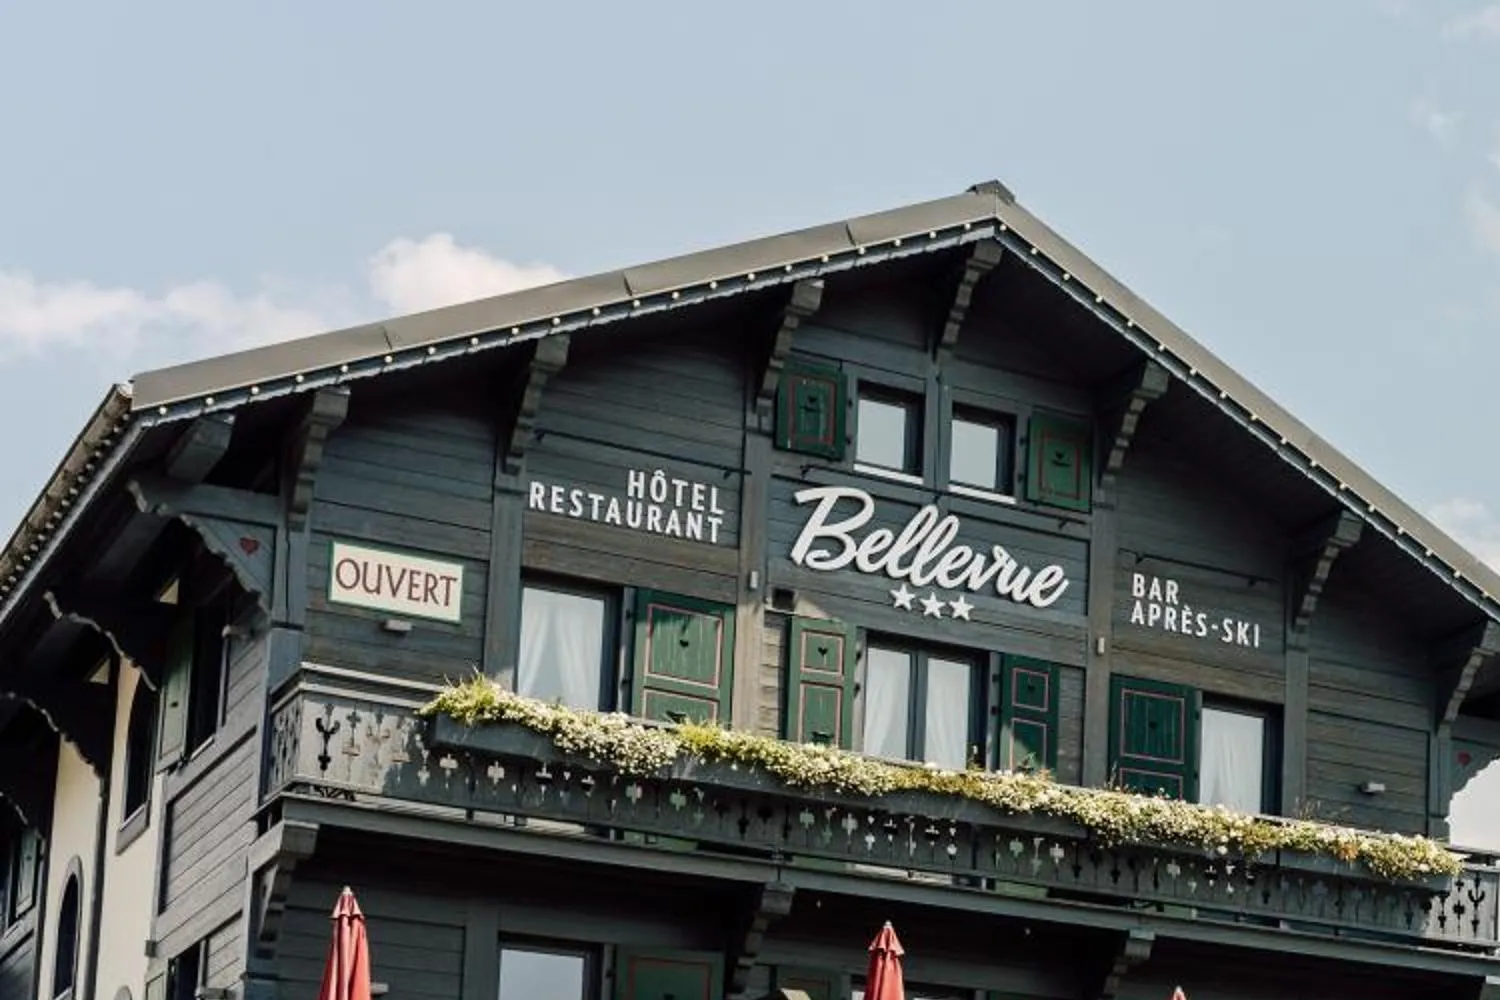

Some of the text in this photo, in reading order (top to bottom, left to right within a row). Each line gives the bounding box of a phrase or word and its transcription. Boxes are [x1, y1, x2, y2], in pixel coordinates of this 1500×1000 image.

[529, 481, 724, 543] RESTAURANT
[627, 469, 724, 515] HÔTEL
[791, 487, 1069, 608] Bellevue
[334, 556, 458, 608] OUVERT
[1131, 572, 1181, 605] BAR
[1129, 604, 1262, 649] APRÈS-SKI
